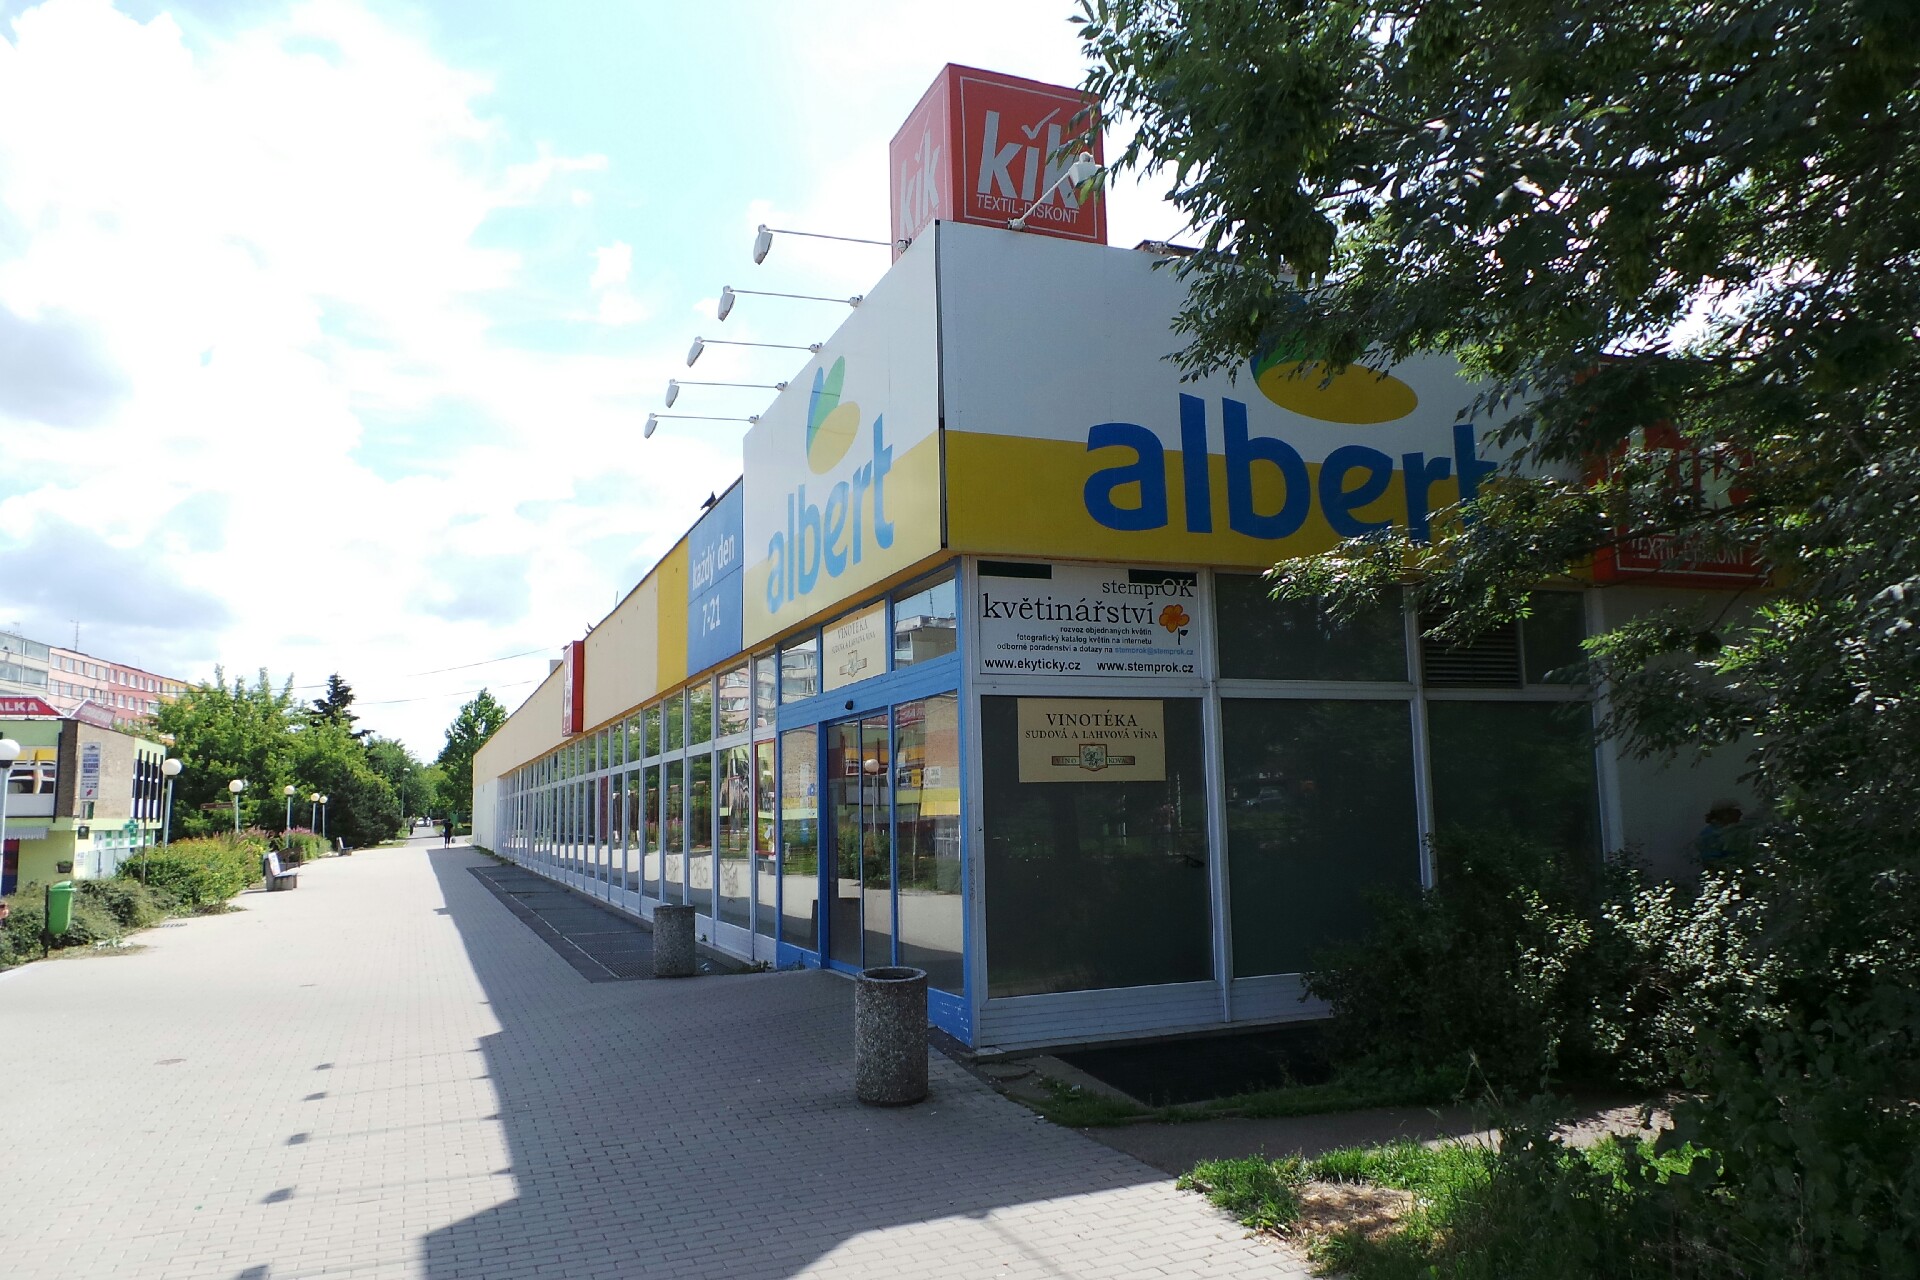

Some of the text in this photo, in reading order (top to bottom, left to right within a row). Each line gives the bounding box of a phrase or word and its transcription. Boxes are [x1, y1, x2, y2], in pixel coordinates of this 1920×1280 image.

[977, 108, 1080, 210] kik
[900, 112, 941, 239] kik
[976, 193, 1079, 224] TEXTIL-DISKONT
[1083, 392, 1498, 548] albert
[766, 413, 894, 614] albert
[692, 533, 735, 591] každý den
[1102, 578, 1194, 598] stemprOK
[702, 593, 721, 637] 7-21
[982, 593, 1155, 625] květinářství
[1016, 633, 1060, 643] fotografický
[1061, 635, 1087, 644] katalog
[1088, 635, 1110, 644] květin
[1122, 637, 1152, 645] internetu
[1085, 626, 1130, 636] objednaných
[1132, 627, 1152, 635] květin
[996, 642, 1027, 650] odborné
[1029, 643, 1072, 653] poradenství
[1079, 646, 1103, 654] dotazy
[984, 658, 1194, 675] www.ekyticky.cz www.stemprok.cz
[1025, 728, 1067, 739] SUDOVÁ
[1083, 728, 1130, 739] LAHVOVÁ
[1134, 729, 1158, 739] VÍNA
[1046, 709, 1138, 727] VINOTÉKA
